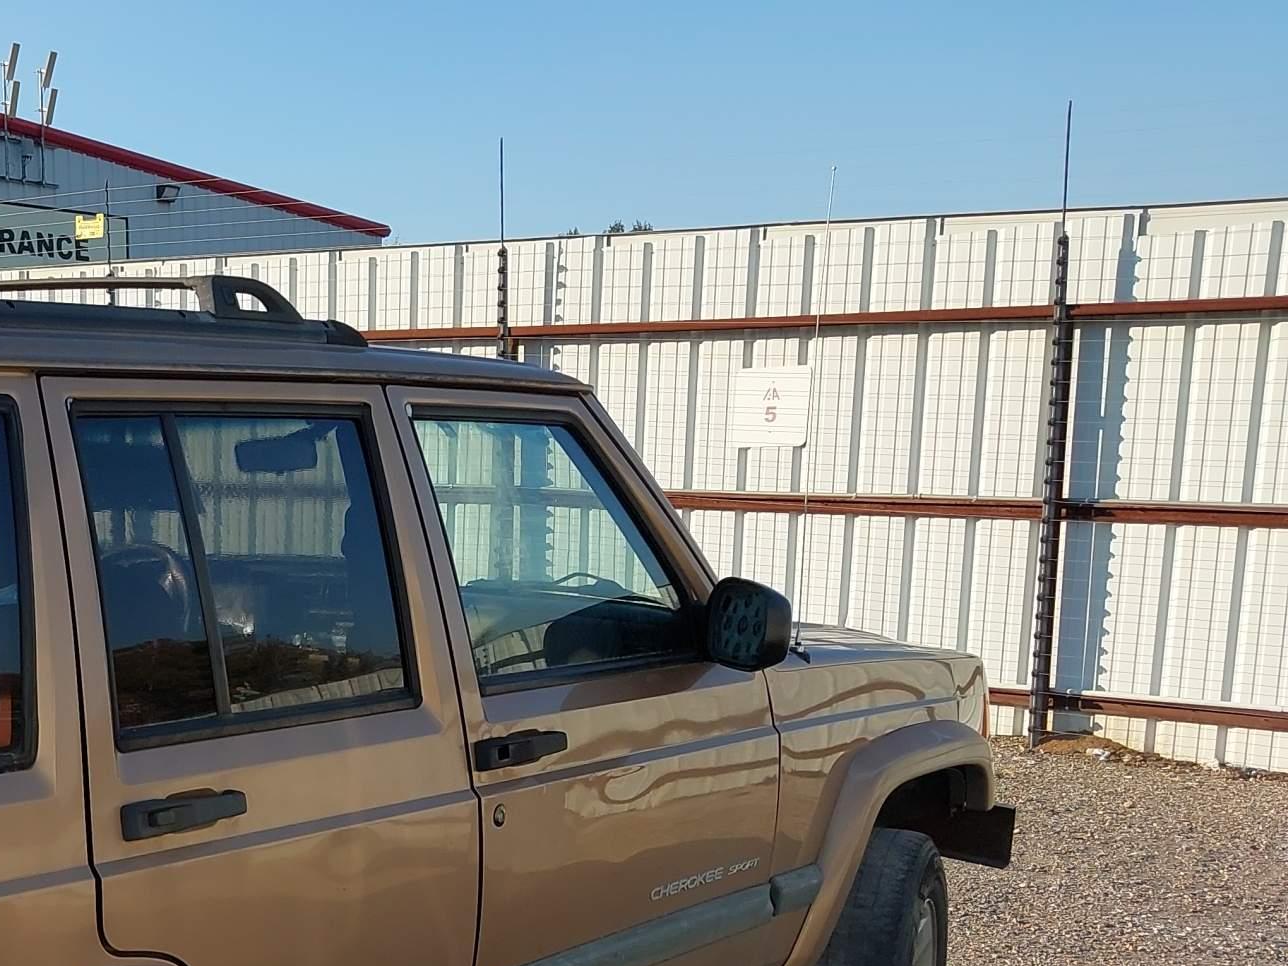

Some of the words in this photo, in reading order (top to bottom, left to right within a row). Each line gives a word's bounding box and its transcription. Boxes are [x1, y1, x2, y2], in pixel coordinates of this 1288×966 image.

[764, 406, 777, 423] 5
[650, 866, 724, 900] CHEROKEE
[727, 857, 760, 876] SPORT
